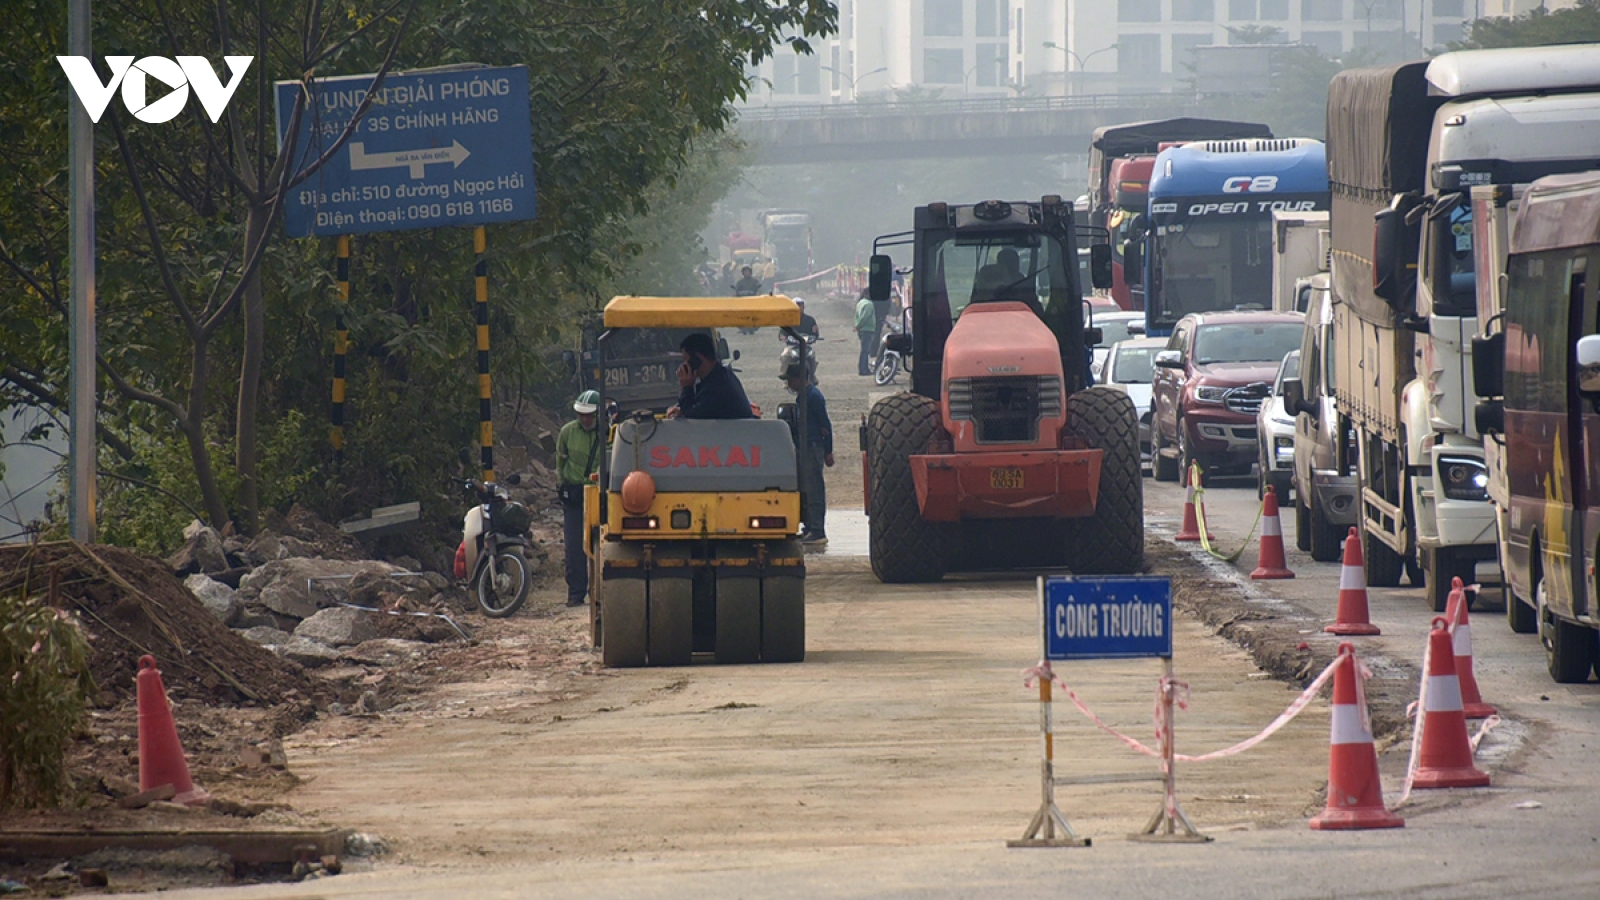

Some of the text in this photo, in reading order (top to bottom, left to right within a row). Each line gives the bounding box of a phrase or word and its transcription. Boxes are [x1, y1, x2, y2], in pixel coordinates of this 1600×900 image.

[395, 78, 434, 104] GIẢI
[440, 76, 510, 100] PHÓNG
[367, 116, 390, 132] 3S
[395, 110, 447, 130] CHÍNH
[451, 106, 499, 126] HÃNG
[299, 171, 525, 208] Địa chỉ: 510 đường Ngọc Hồi
[1222, 175, 1279, 193] G8
[316, 198, 513, 229] Điện thoại: 090 618 1166
[1188, 201, 1249, 216] OPEN
[1257, 200, 1317, 213] TOUR
[649, 445, 761, 468] SAKAI
[1055, 595, 1163, 638] CÔNG TRƯỜNG
